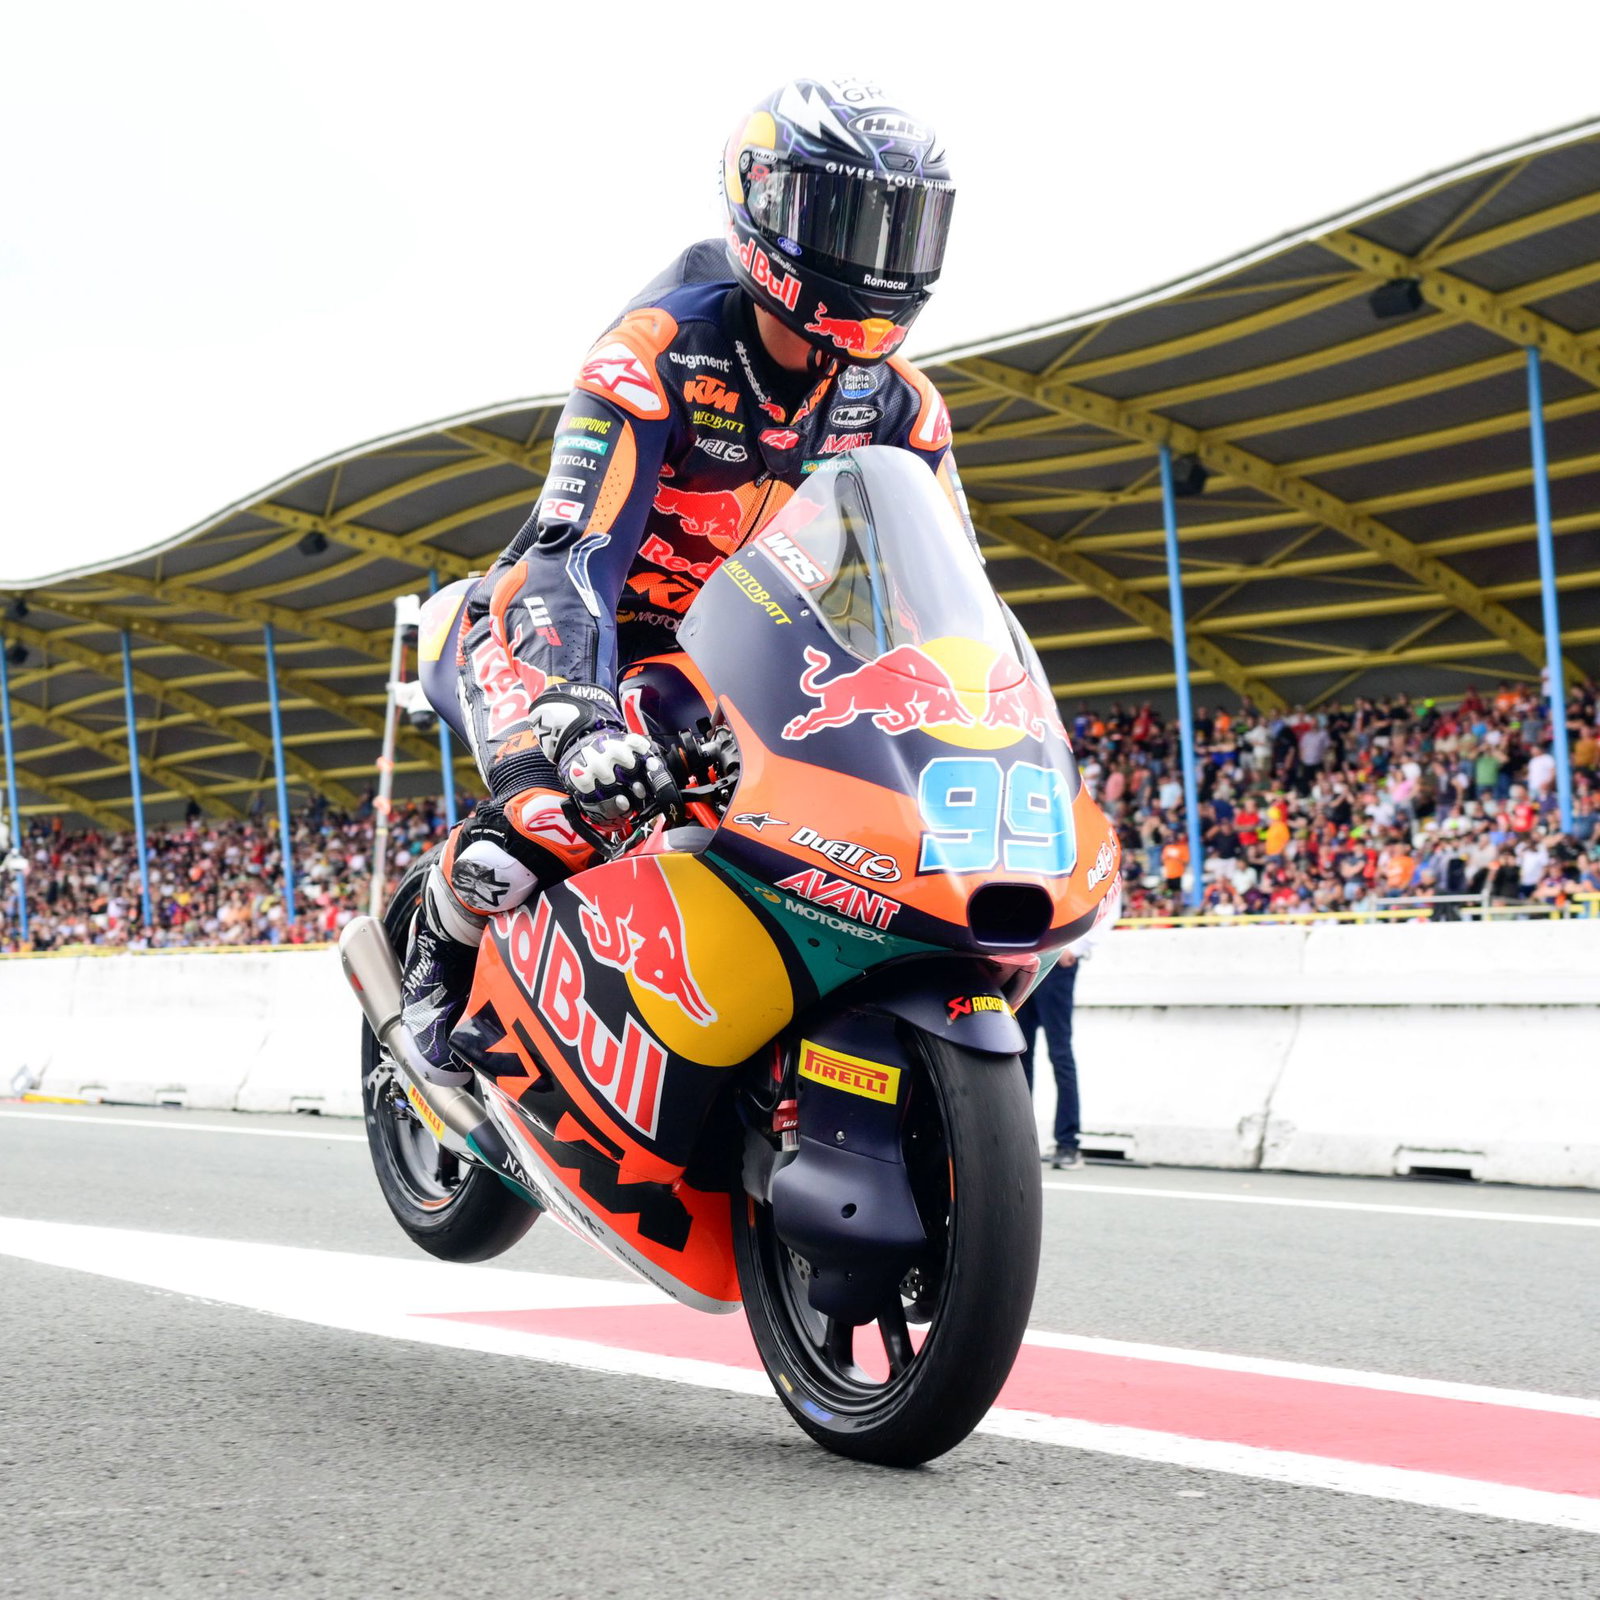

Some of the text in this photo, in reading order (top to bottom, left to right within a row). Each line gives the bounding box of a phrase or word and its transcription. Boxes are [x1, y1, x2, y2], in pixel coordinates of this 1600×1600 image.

[826, 162, 875, 181] GIVES
[885, 173, 917, 190] YOU
[751, 246, 802, 312] Bull
[864, 274, 908, 291] Romacar
[669, 351, 731, 373] augment
[683, 374, 740, 415] KTM
[833, 410, 873, 422] HJC
[817, 432, 873, 455] AVANT
[637, 532, 726, 584] Red
[721, 560, 792, 625] MOTOBATT
[917, 756, 1078, 877] 99
[773, 868, 902, 931] AVANT
[785, 898, 887, 944] MOTOREX
[537, 919, 668, 1141] Bull
[803, 1047, 890, 1096] PIRELLI
